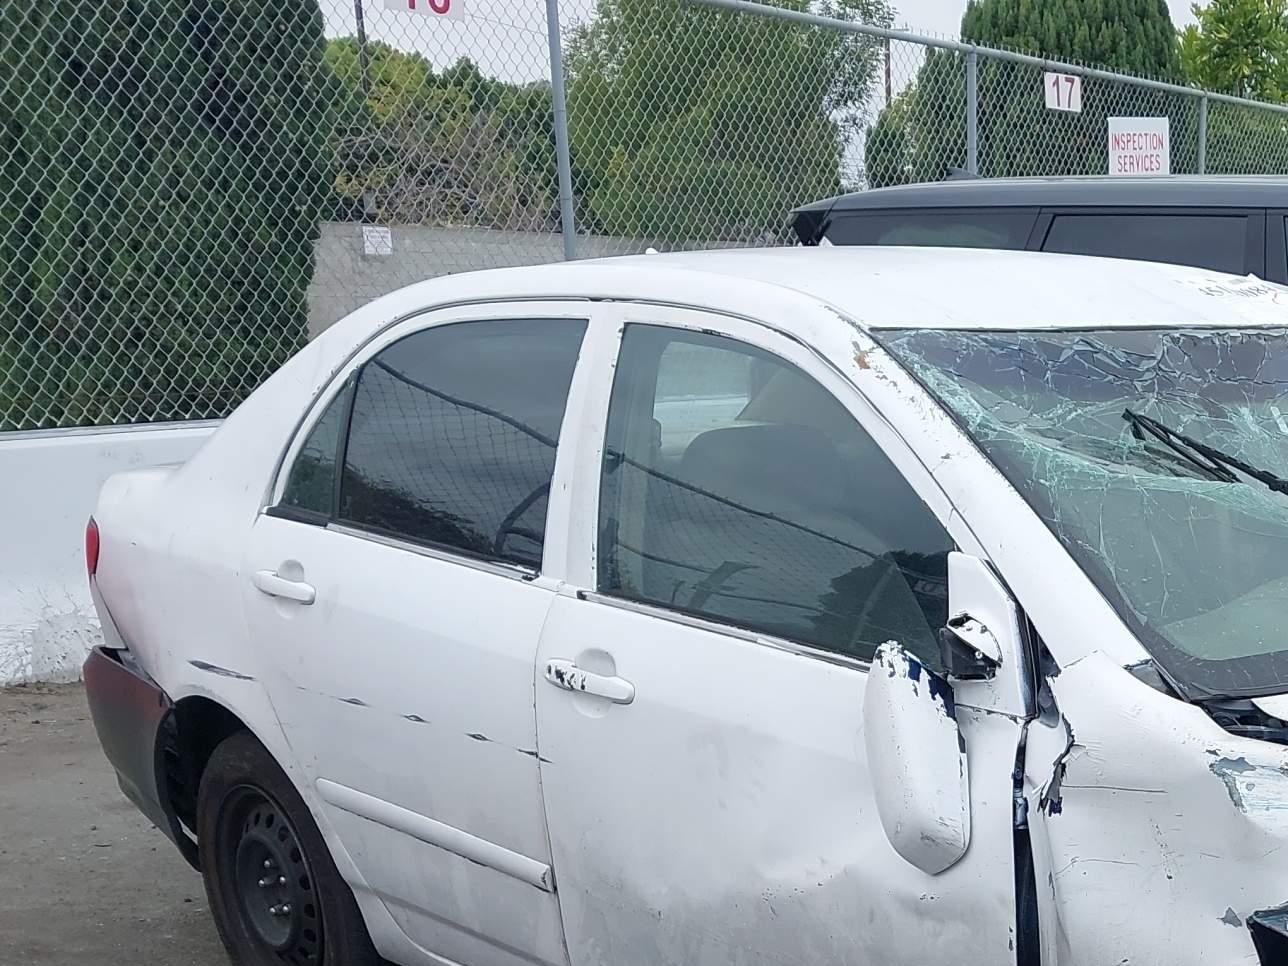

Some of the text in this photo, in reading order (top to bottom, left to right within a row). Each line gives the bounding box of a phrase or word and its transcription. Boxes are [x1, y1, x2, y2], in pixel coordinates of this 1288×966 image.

[1052, 75, 1075, 108] 17
[1111, 132, 1163, 151] INSPECTION
[1117, 154, 1160, 173] SERVICES
